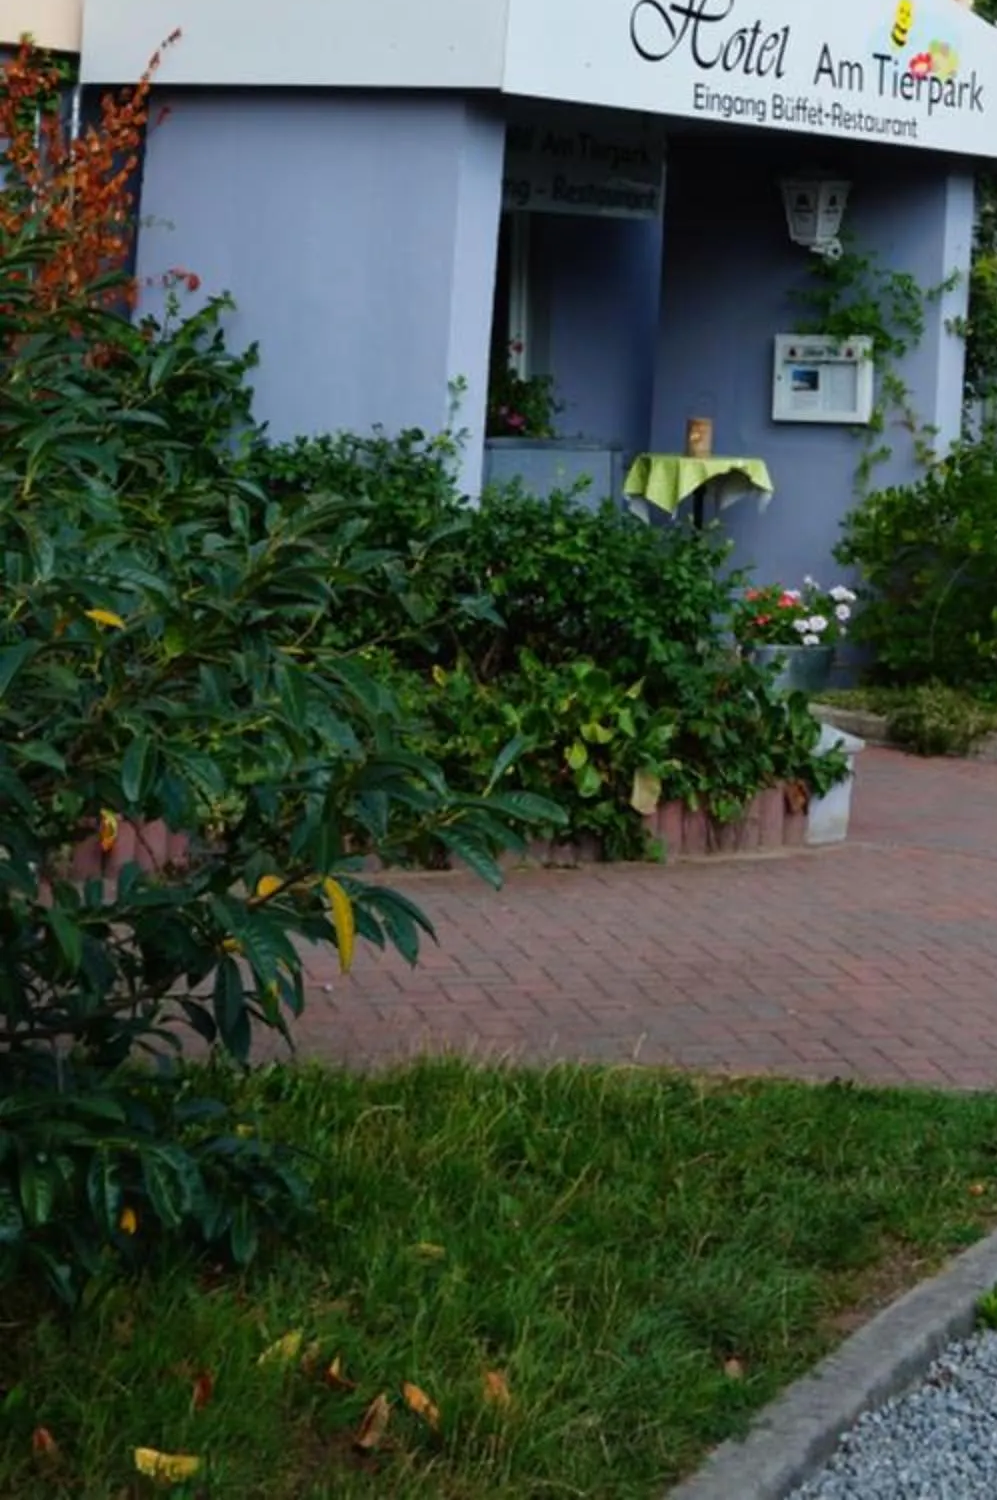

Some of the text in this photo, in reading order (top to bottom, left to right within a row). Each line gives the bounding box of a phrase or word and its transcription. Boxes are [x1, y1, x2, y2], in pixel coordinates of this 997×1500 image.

[693, 83, 767, 122] Eingang
[813, 43, 864, 92] Am
[872, 53, 984, 116] Tierpark
